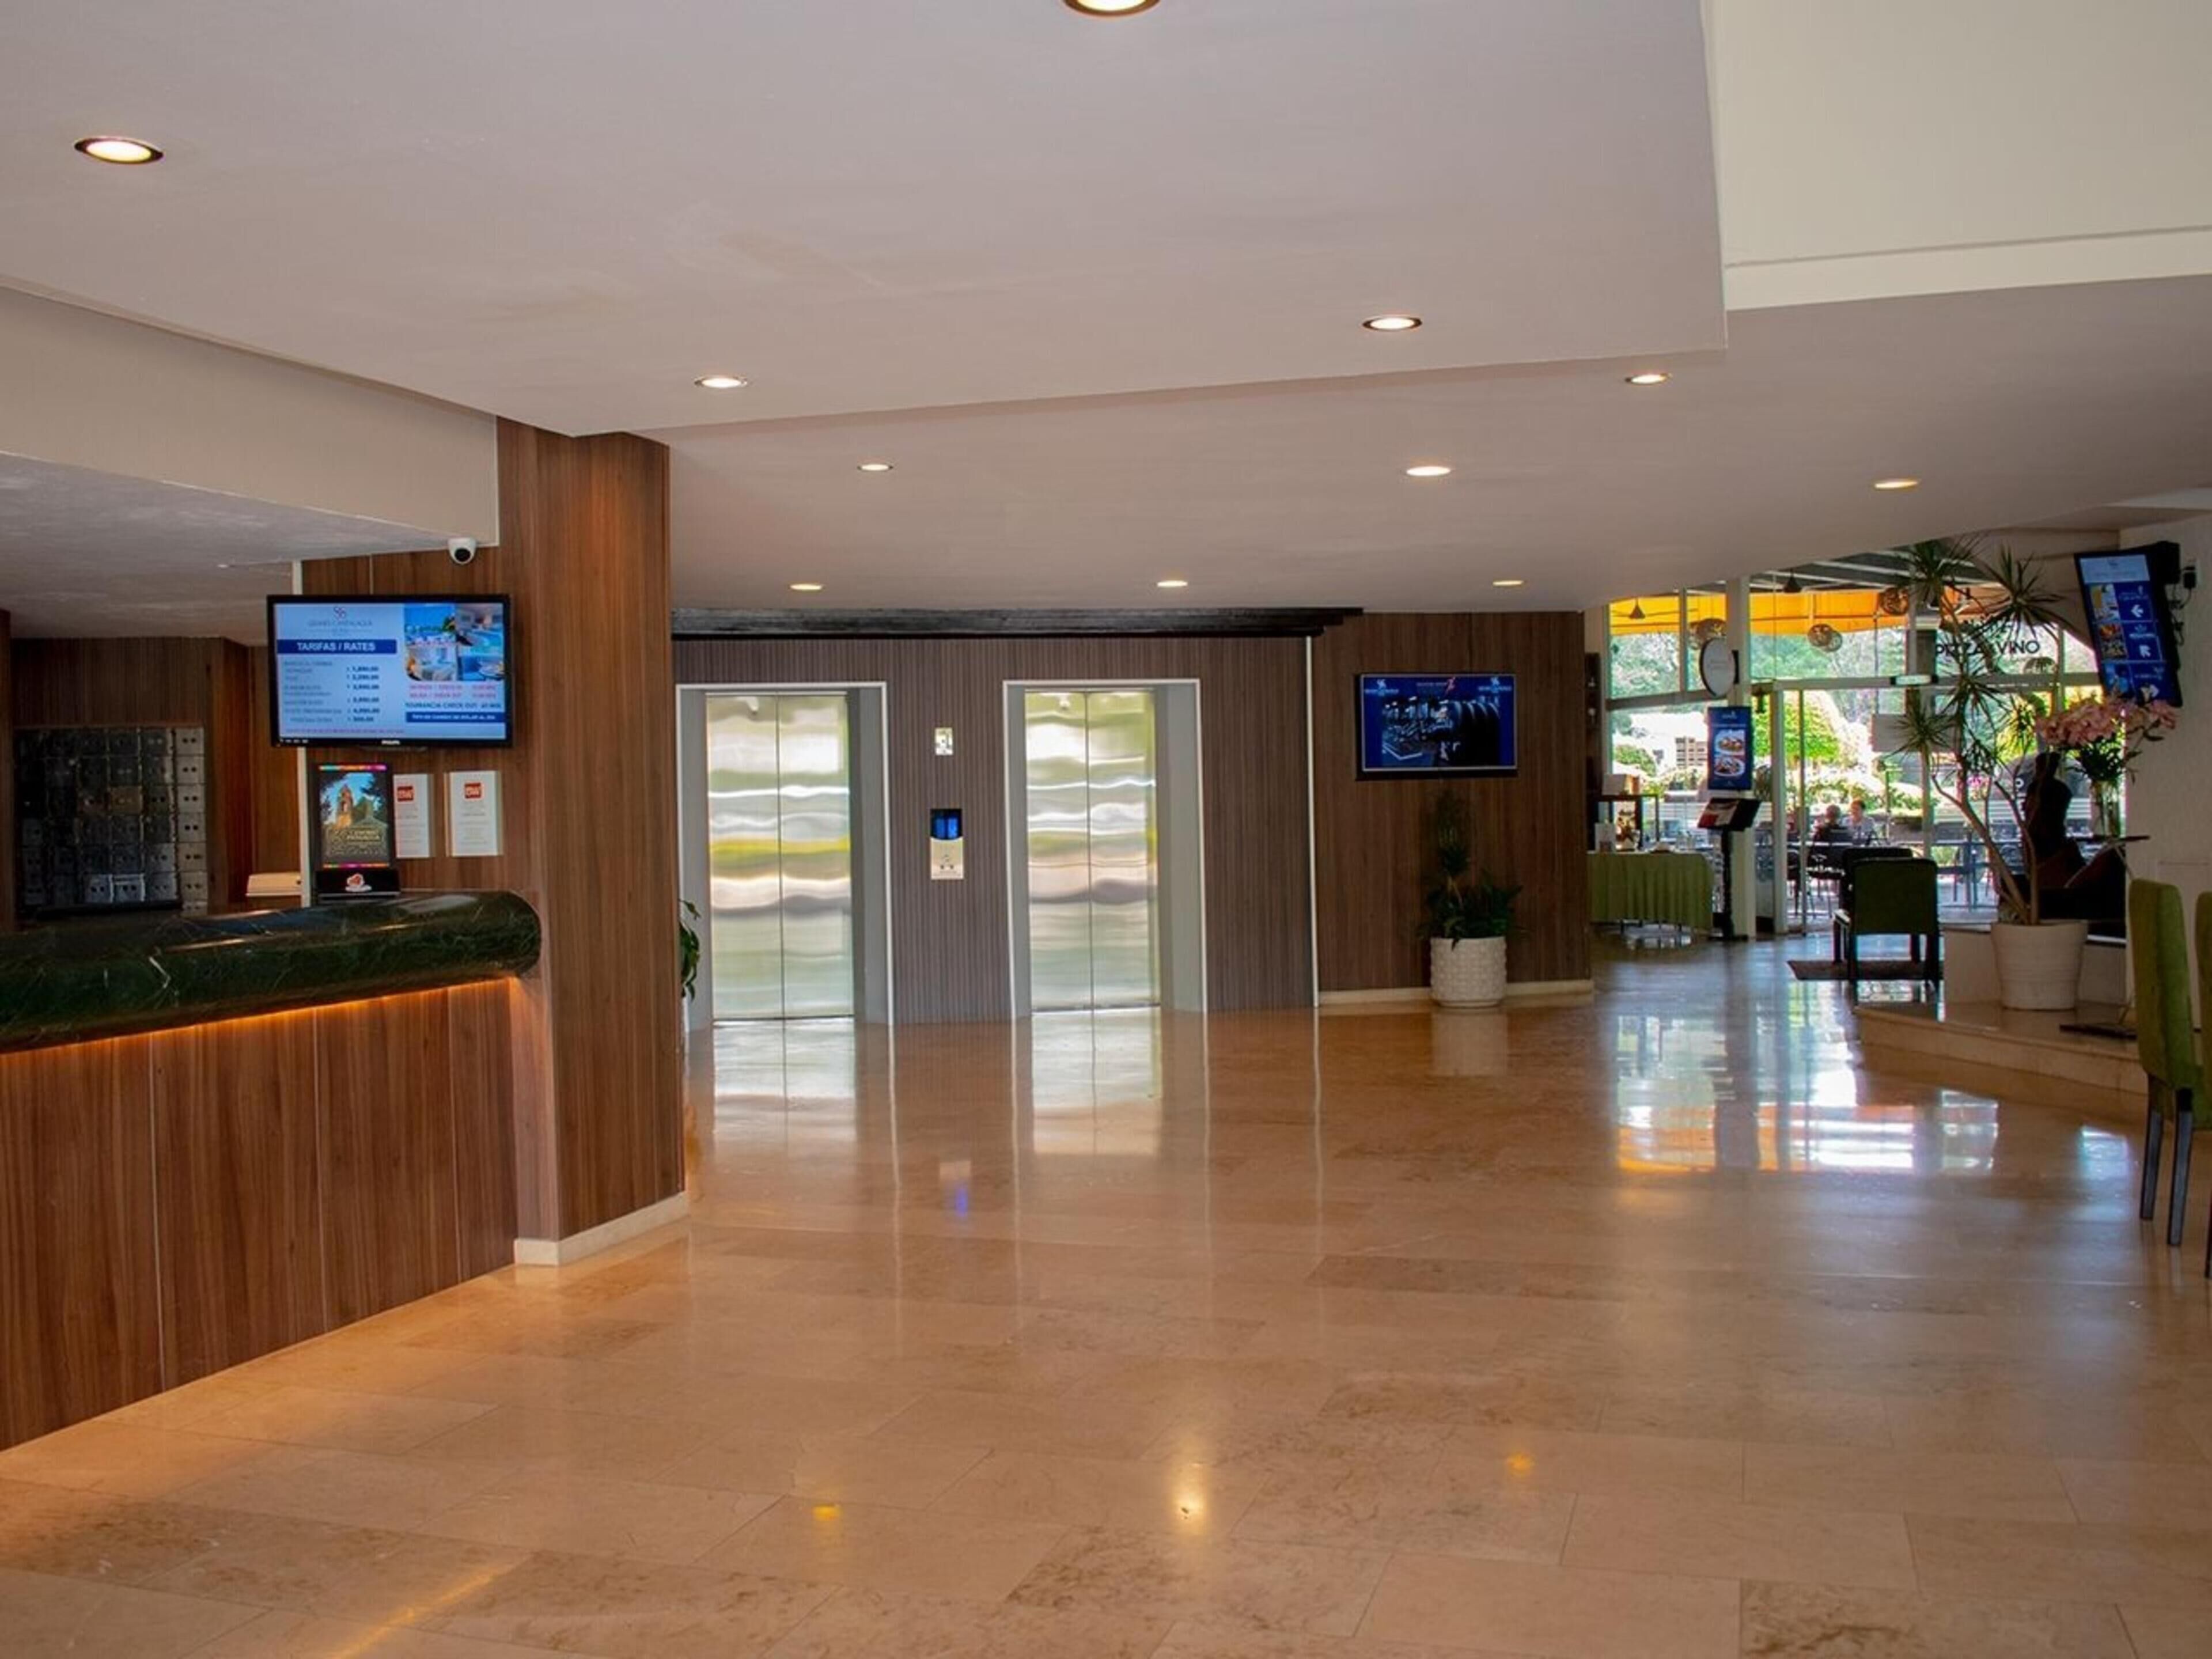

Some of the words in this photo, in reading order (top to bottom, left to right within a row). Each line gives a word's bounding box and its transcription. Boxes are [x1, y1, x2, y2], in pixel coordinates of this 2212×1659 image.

[297, 642, 336, 651] TARIFAS
[343, 642, 376, 651] RATES
[1996, 640, 2040, 655] VINO
